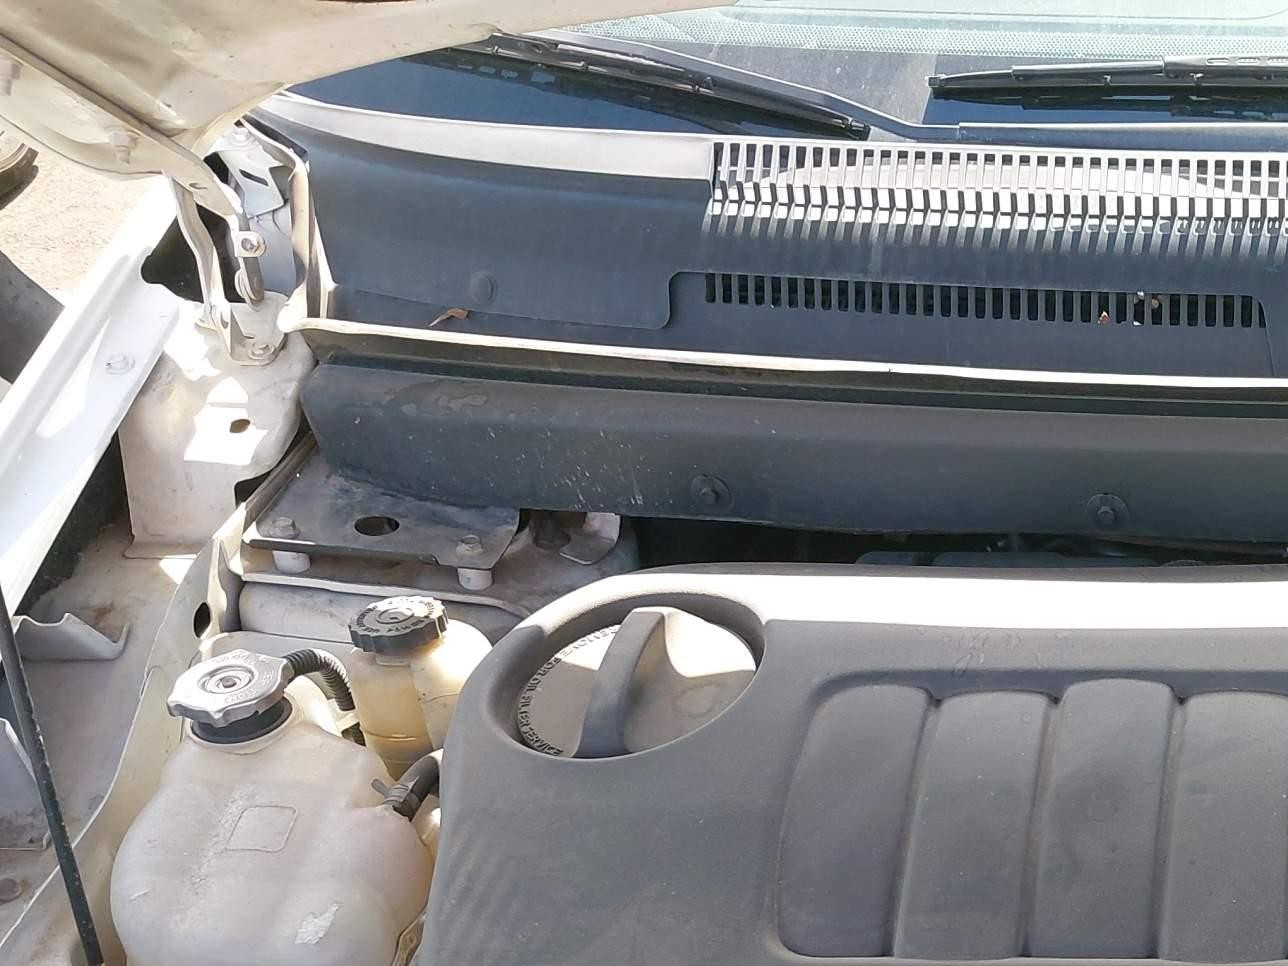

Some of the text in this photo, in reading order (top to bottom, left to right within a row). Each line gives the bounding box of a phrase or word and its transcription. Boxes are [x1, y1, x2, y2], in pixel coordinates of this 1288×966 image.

[538, 656, 563, 678] FOR
[526, 676, 542, 694] OIL
[522, 727, 564, 757] SERVICE
